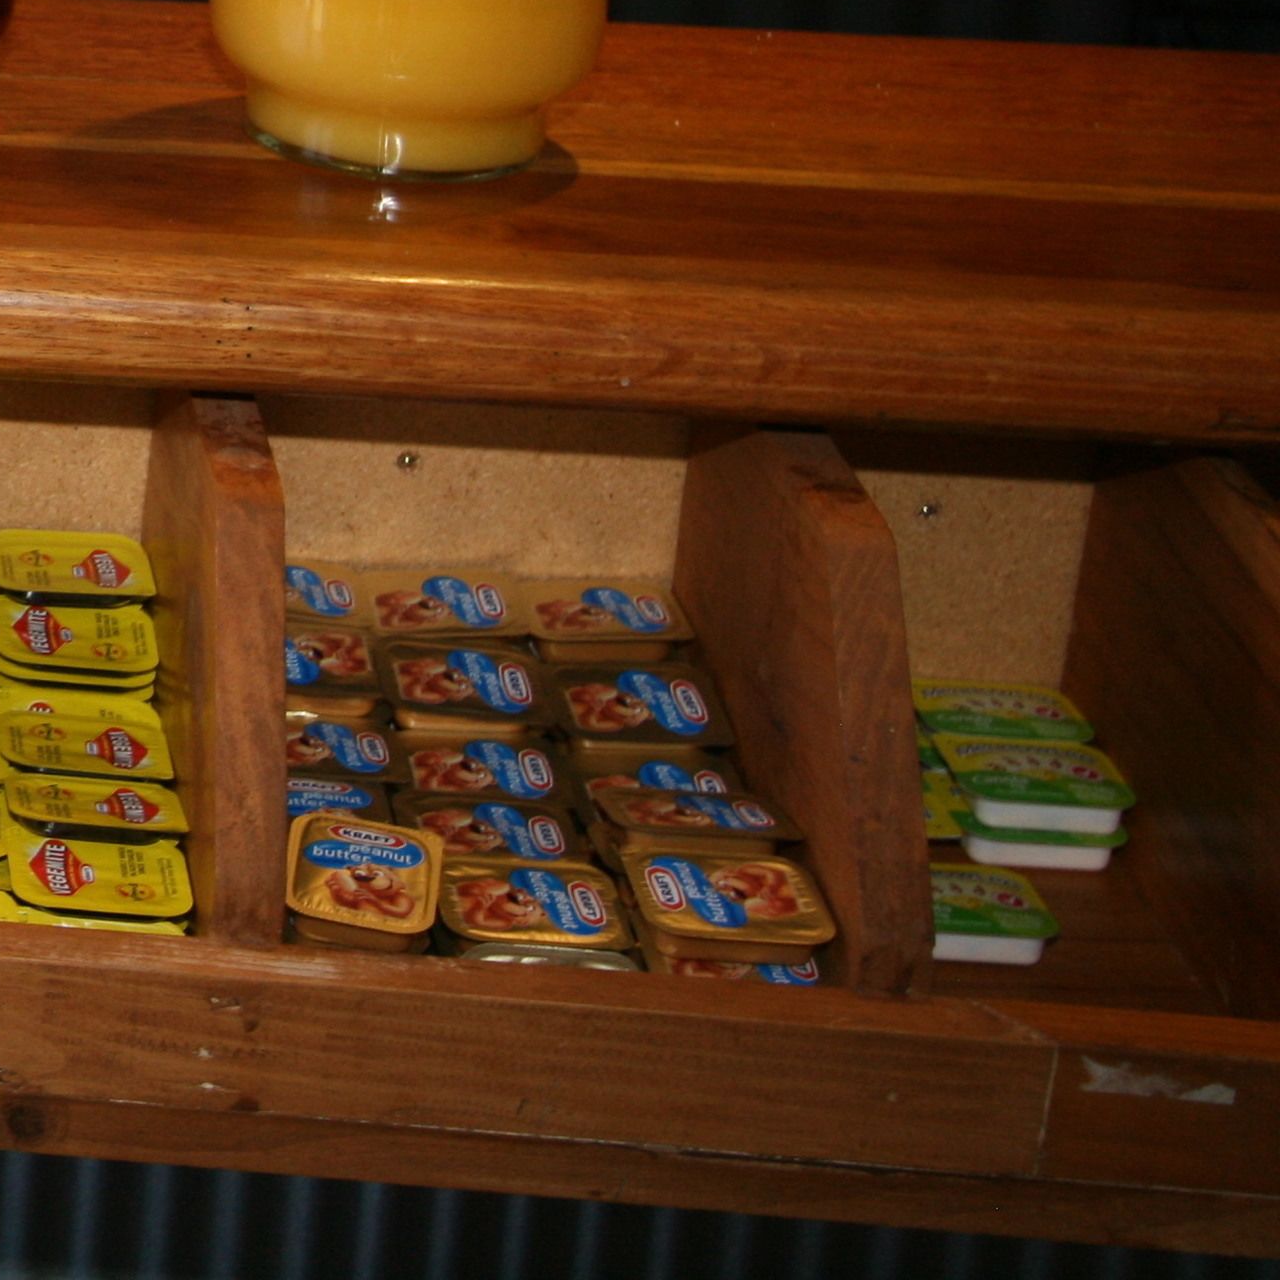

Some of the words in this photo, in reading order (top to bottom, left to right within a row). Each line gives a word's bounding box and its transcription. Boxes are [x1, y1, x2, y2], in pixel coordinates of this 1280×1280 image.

[288, 798, 327, 806] utter
[303, 792, 363, 804] peanut
[342, 828, 391, 844] KRAFT
[312, 846, 372, 863] butter
[349, 845, 412, 865] peanut
[45, 844, 72, 894] VEGEMITE
[654, 875, 675, 904] KRAFT
[579, 890, 598, 919] KRAFT
